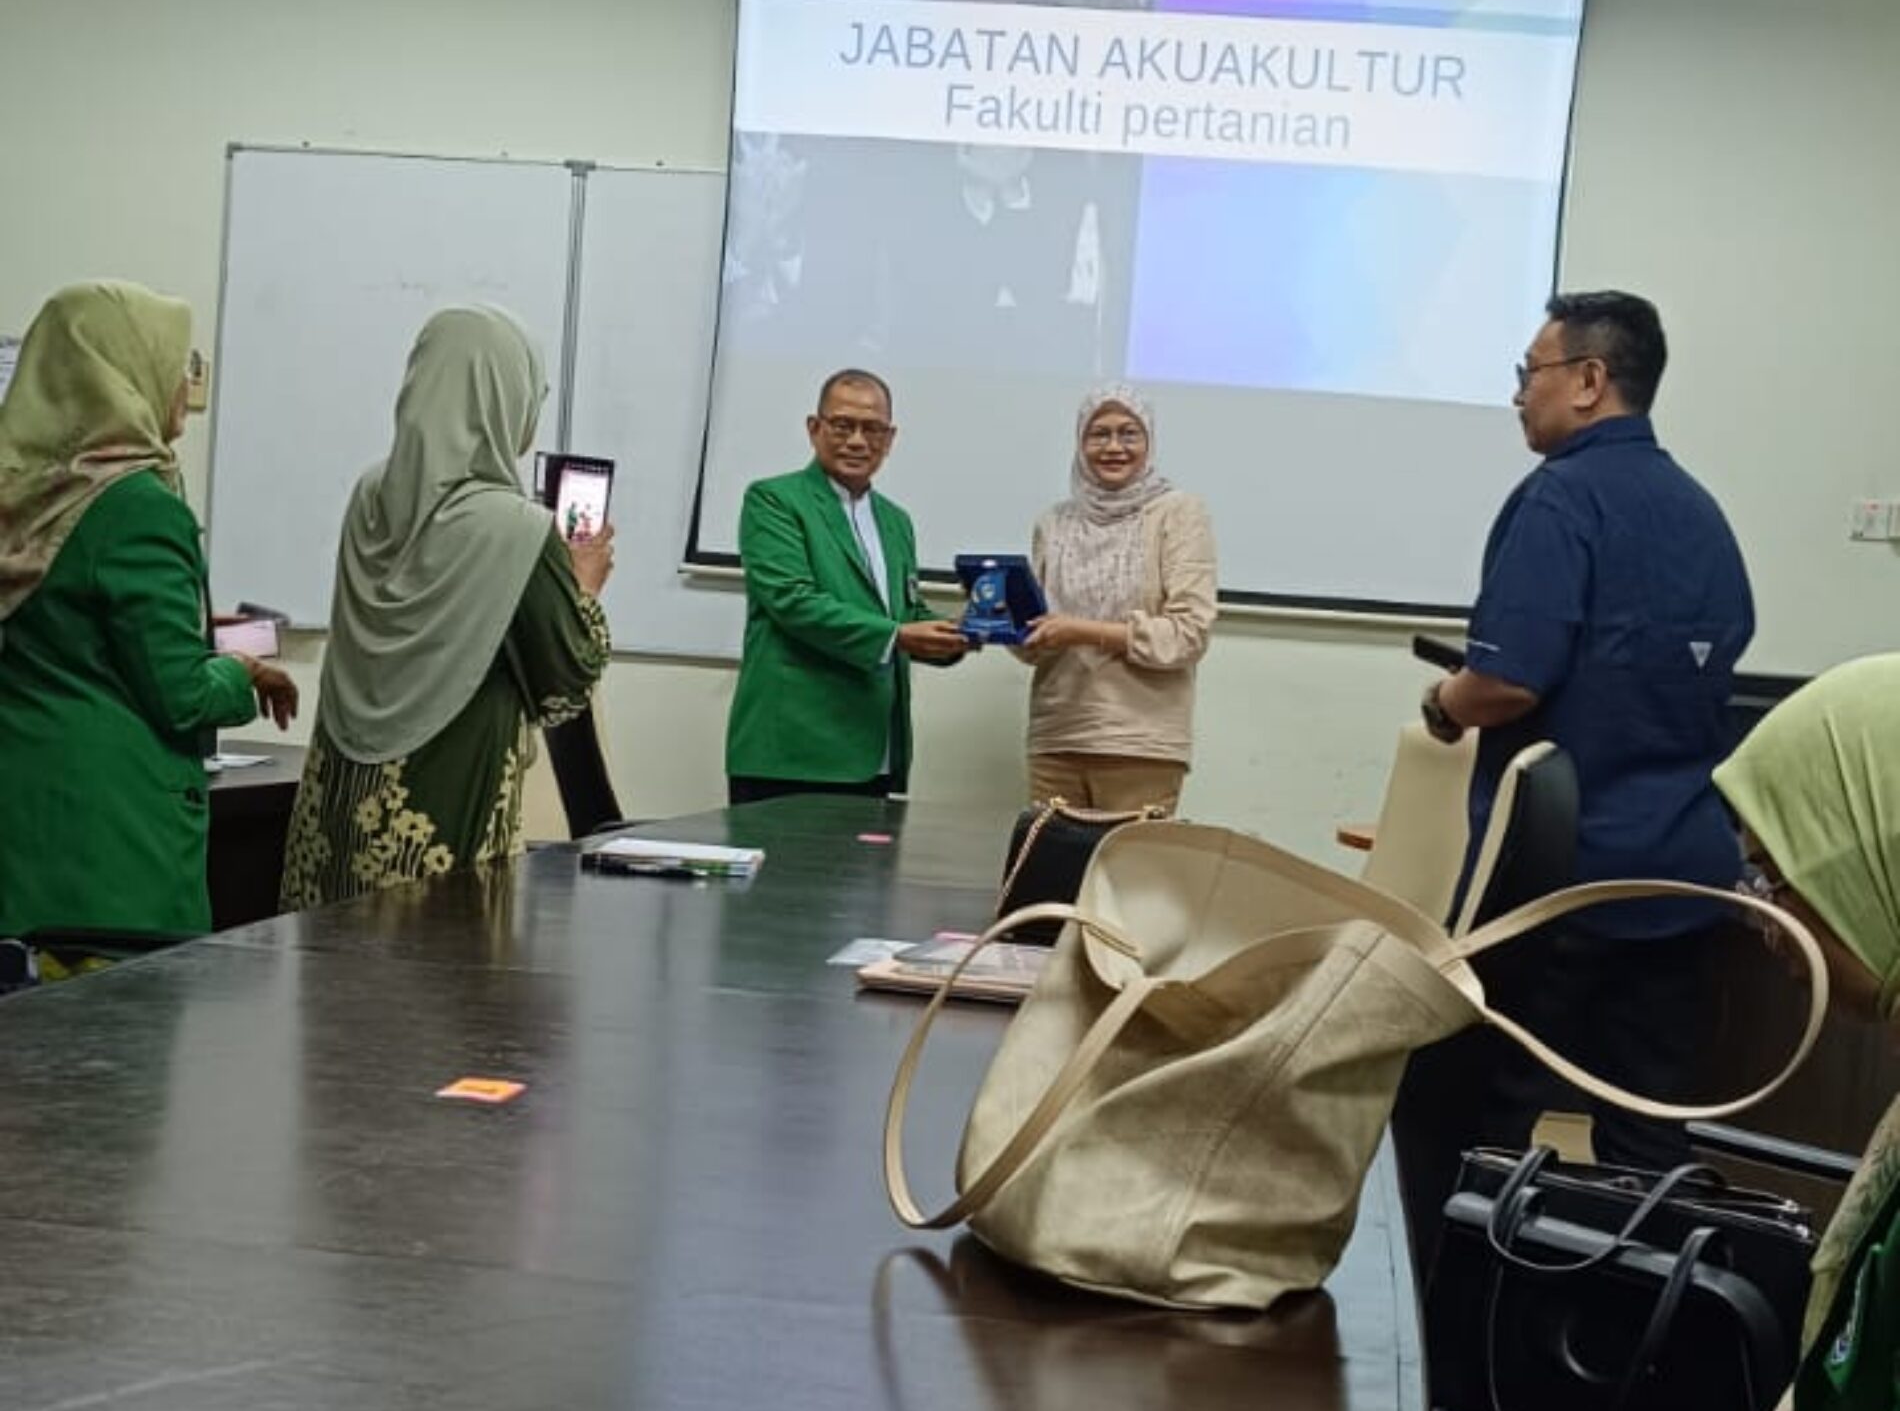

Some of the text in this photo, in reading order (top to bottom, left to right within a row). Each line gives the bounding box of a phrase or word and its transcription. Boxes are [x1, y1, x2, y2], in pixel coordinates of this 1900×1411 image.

[840, 22, 1467, 99] JABATAN AKUAKULTUR
[944, 83, 1352, 150] Fakulti pertanian
